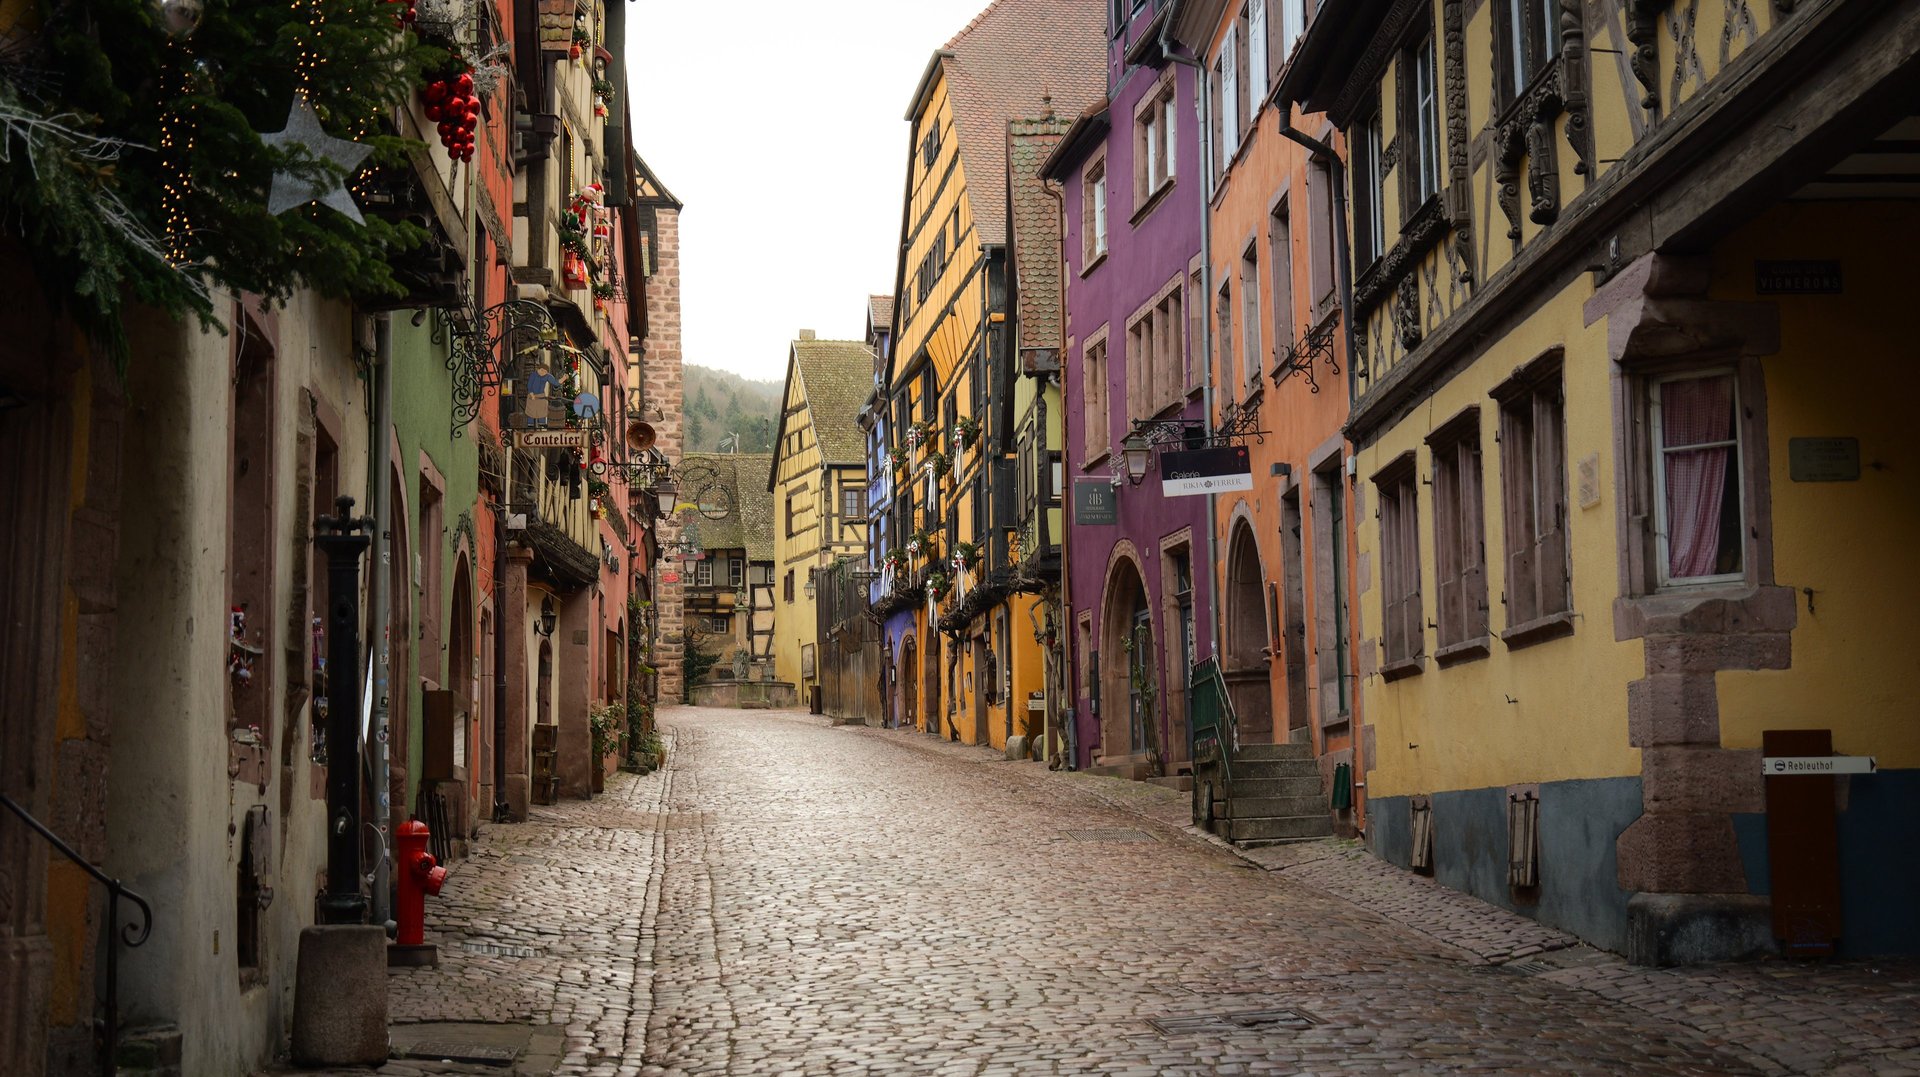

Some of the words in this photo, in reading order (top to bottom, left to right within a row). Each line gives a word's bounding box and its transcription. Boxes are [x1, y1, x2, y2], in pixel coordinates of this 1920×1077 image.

[1760, 277, 1839, 289] VIGNERONS
[523, 433, 580, 445] Coutelier
[1170, 471, 1200, 481] Galerie
[1213, 478, 1241, 487] FERRER
[1788, 760, 1833, 771] Rebleuthof
